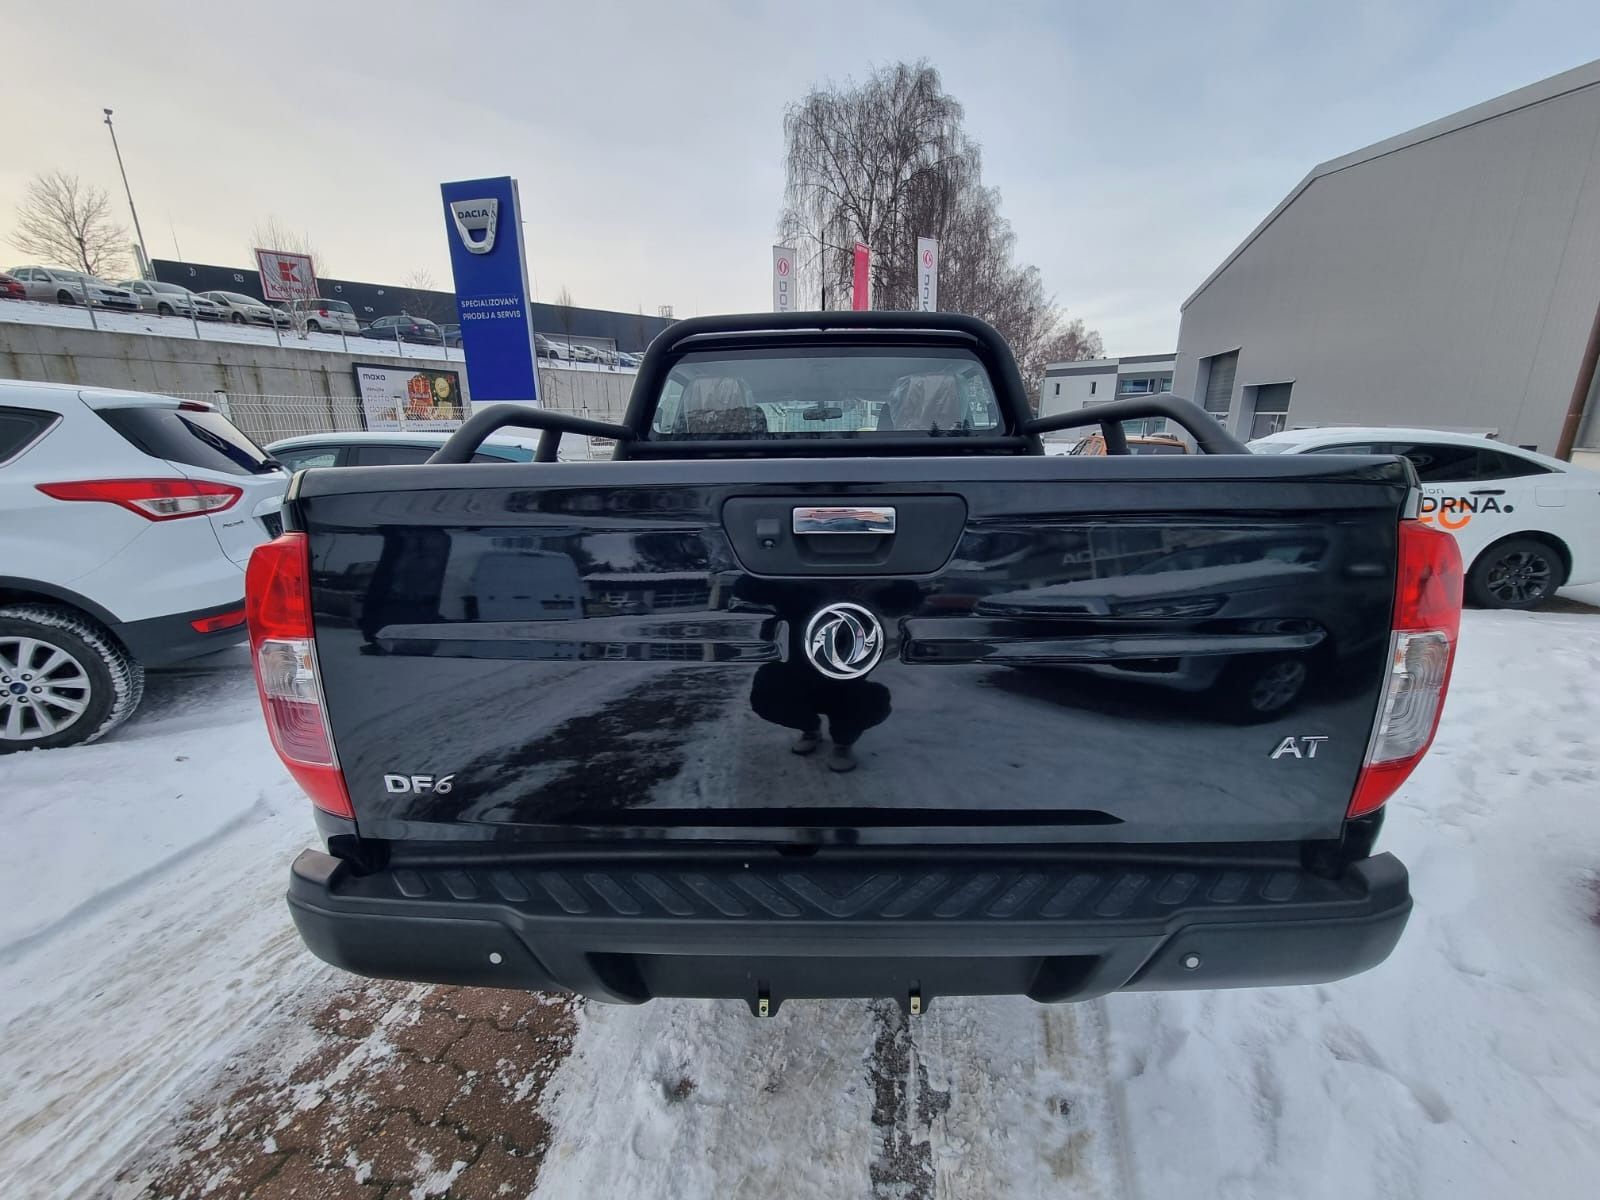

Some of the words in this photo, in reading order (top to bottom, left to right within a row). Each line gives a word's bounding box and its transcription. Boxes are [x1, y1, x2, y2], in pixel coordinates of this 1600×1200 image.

[457, 209, 489, 219] DACIA
[462, 312, 490, 321] PRODEJ
[490, 311, 496, 319] A
[496, 310, 521, 319] SERVIS
[1270, 735, 1329, 760] AT
[383, 773, 456, 795] DF6
